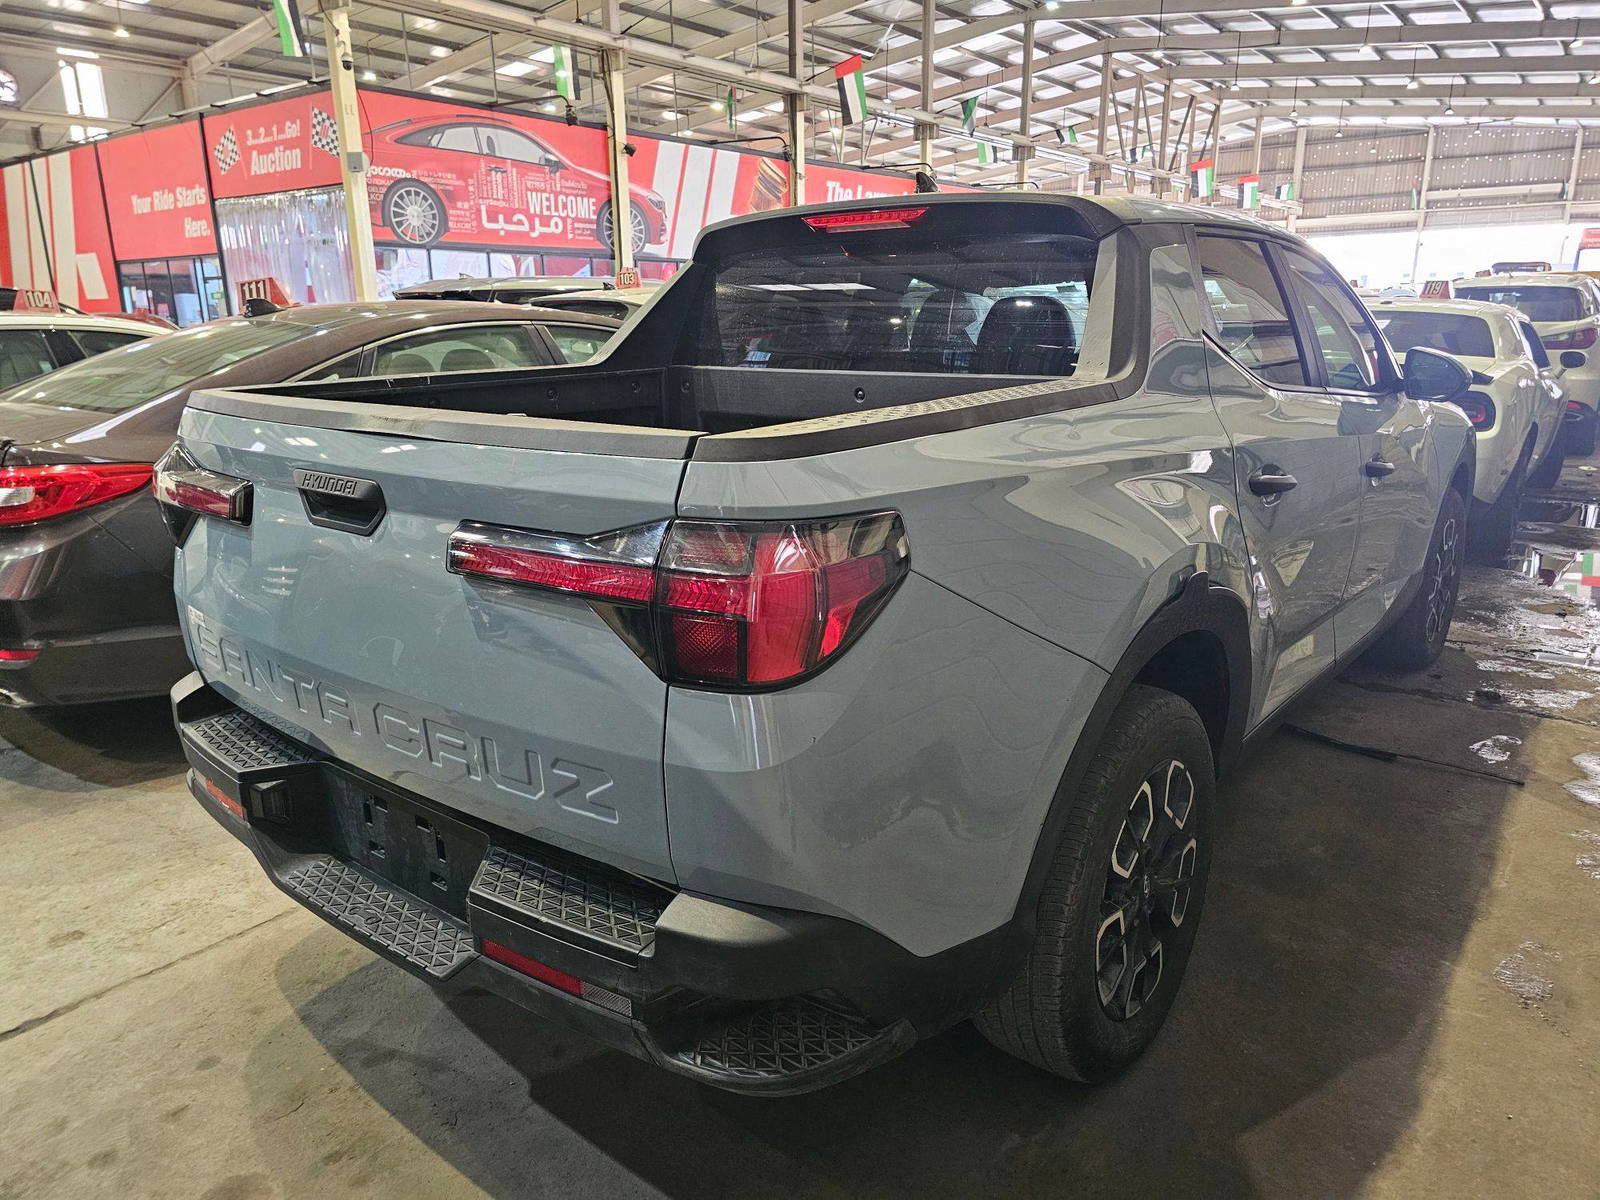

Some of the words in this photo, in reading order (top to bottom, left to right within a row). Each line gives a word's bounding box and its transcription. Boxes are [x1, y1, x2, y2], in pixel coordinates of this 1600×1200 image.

[251, 145, 302, 175] Auction
[131, 193, 151, 215] Your
[153, 189, 175, 211] Ride
[176, 184, 207, 208] Starts
[527, 191, 597, 219] WELCOME
[184, 216, 211, 239] Here.
[480, 204, 563, 238] مرحبا
[242, 280, 266, 300] 111
[620, 273, 635, 285] 103
[1424, 281, 1442, 296] 119
[26, 290, 53, 308] 104
[301, 473, 358, 496] HYUNDAI
[196, 624, 362, 737] SANTA
[373, 701, 620, 825] CRUZ
